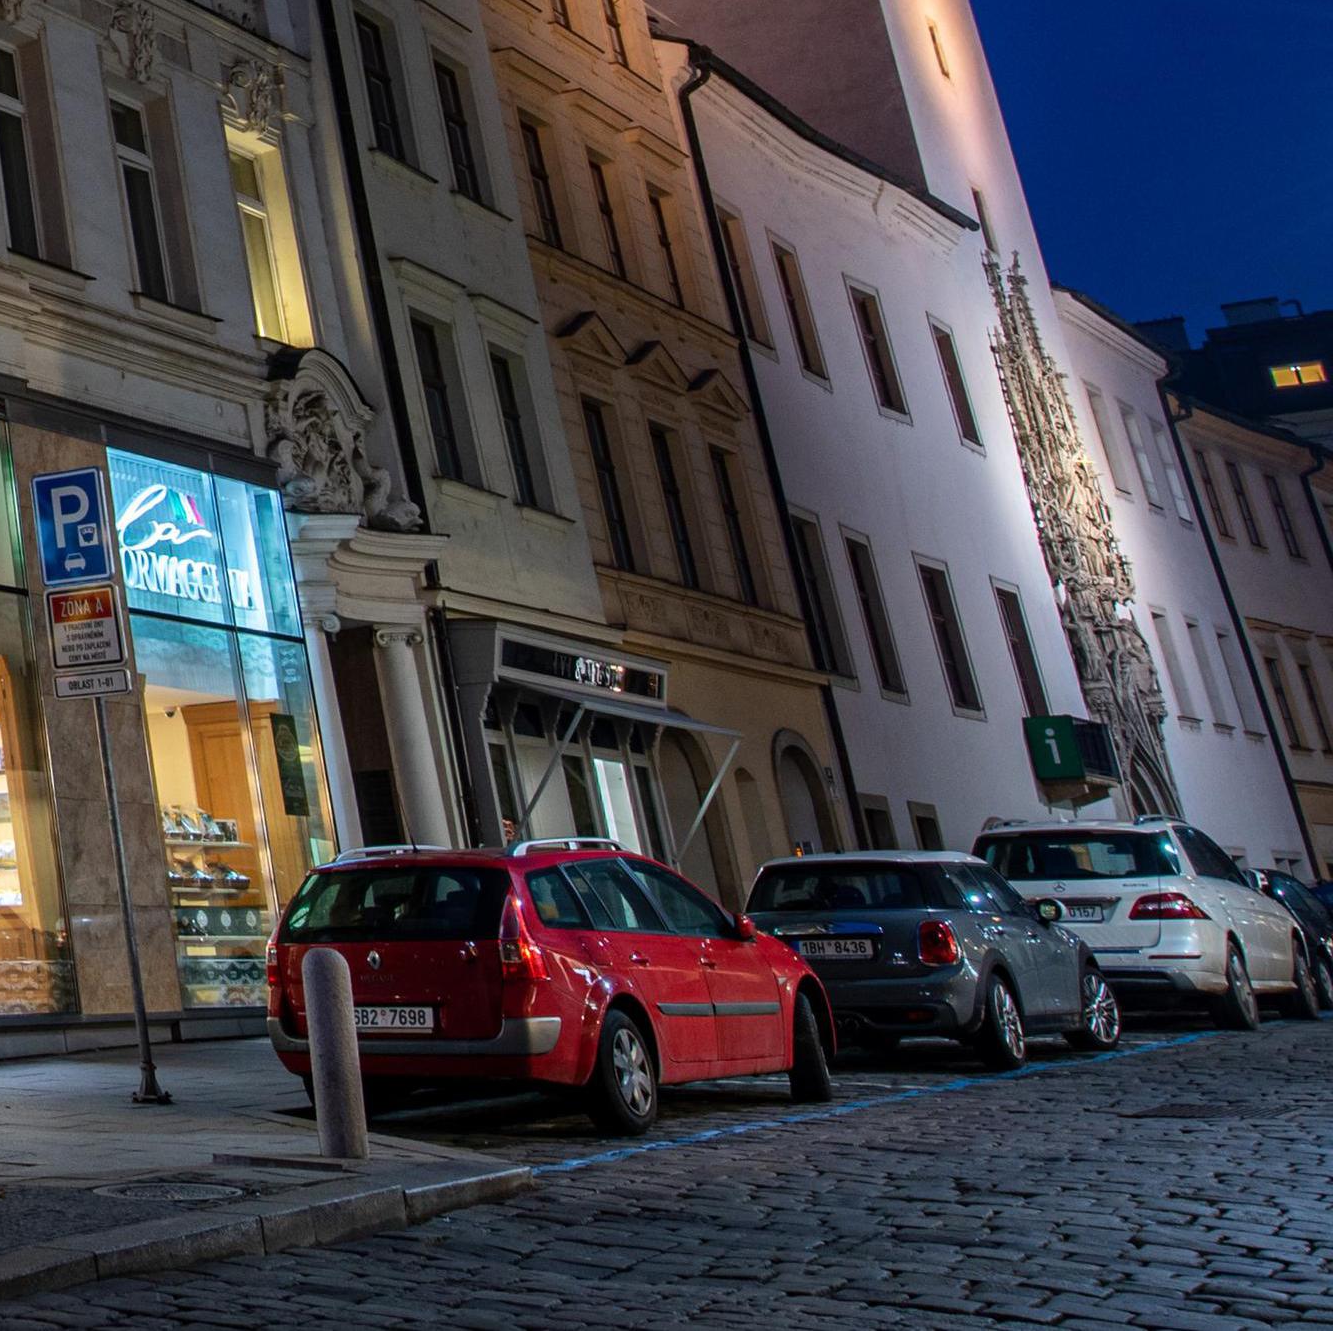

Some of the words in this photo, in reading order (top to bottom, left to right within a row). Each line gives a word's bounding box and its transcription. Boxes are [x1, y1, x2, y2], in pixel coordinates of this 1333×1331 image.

[51, 485, 89, 548] P
[120, 548, 256, 610] ORMAGGIA
[61, 597, 92, 618] ZÓNA
[96, 597, 103, 614] A
[76, 643, 83, 651] PO
[69, 678, 94, 690] OBLAST
[98, 677, 113, 687] 1-01
[802, 941, 825, 954] 1BH
[834, 941, 867, 954] 8436
[389, 1009, 426, 1025] 7698
